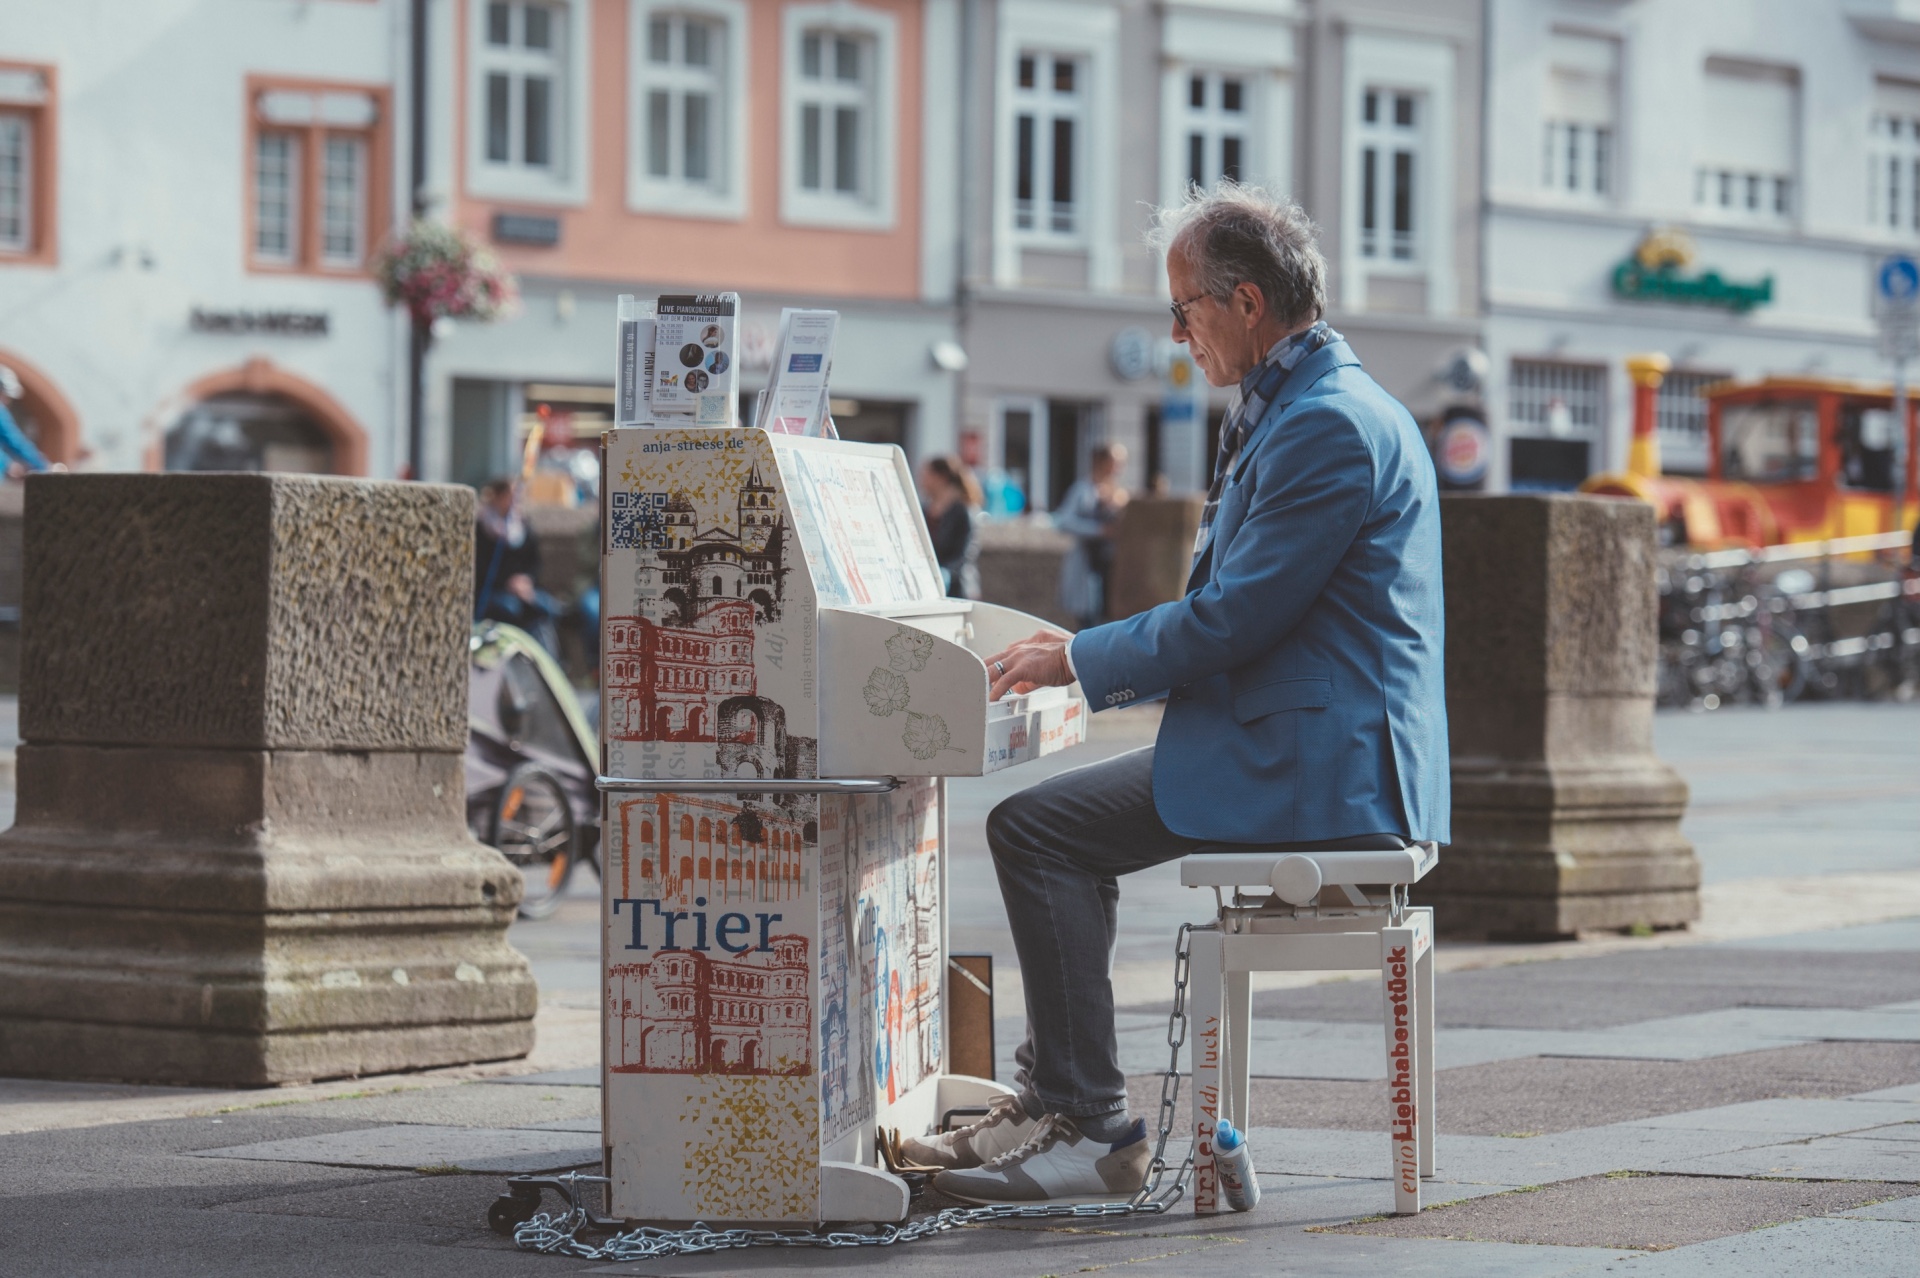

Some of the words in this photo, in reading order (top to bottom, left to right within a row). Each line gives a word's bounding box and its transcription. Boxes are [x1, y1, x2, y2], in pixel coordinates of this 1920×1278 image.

[660, 305, 675, 313] LIVE
[676, 306, 719, 315] PIANOKONZERTE
[625, 363, 634, 396] September
[625, 397, 633, 411] 2021
[642, 437, 744, 455] anja-streese.de
[763, 627, 788, 671] Adj.
[800, 596, 815, 699] anja-streese.de
[613, 896, 782, 953] Trier
[1198, 1015, 1220, 1070] lucky
[1387, 945, 1415, 1142] Liebhaberstück
[1198, 1079, 1219, 1120] Adj.
[1194, 1122, 1216, 1213] Trier
